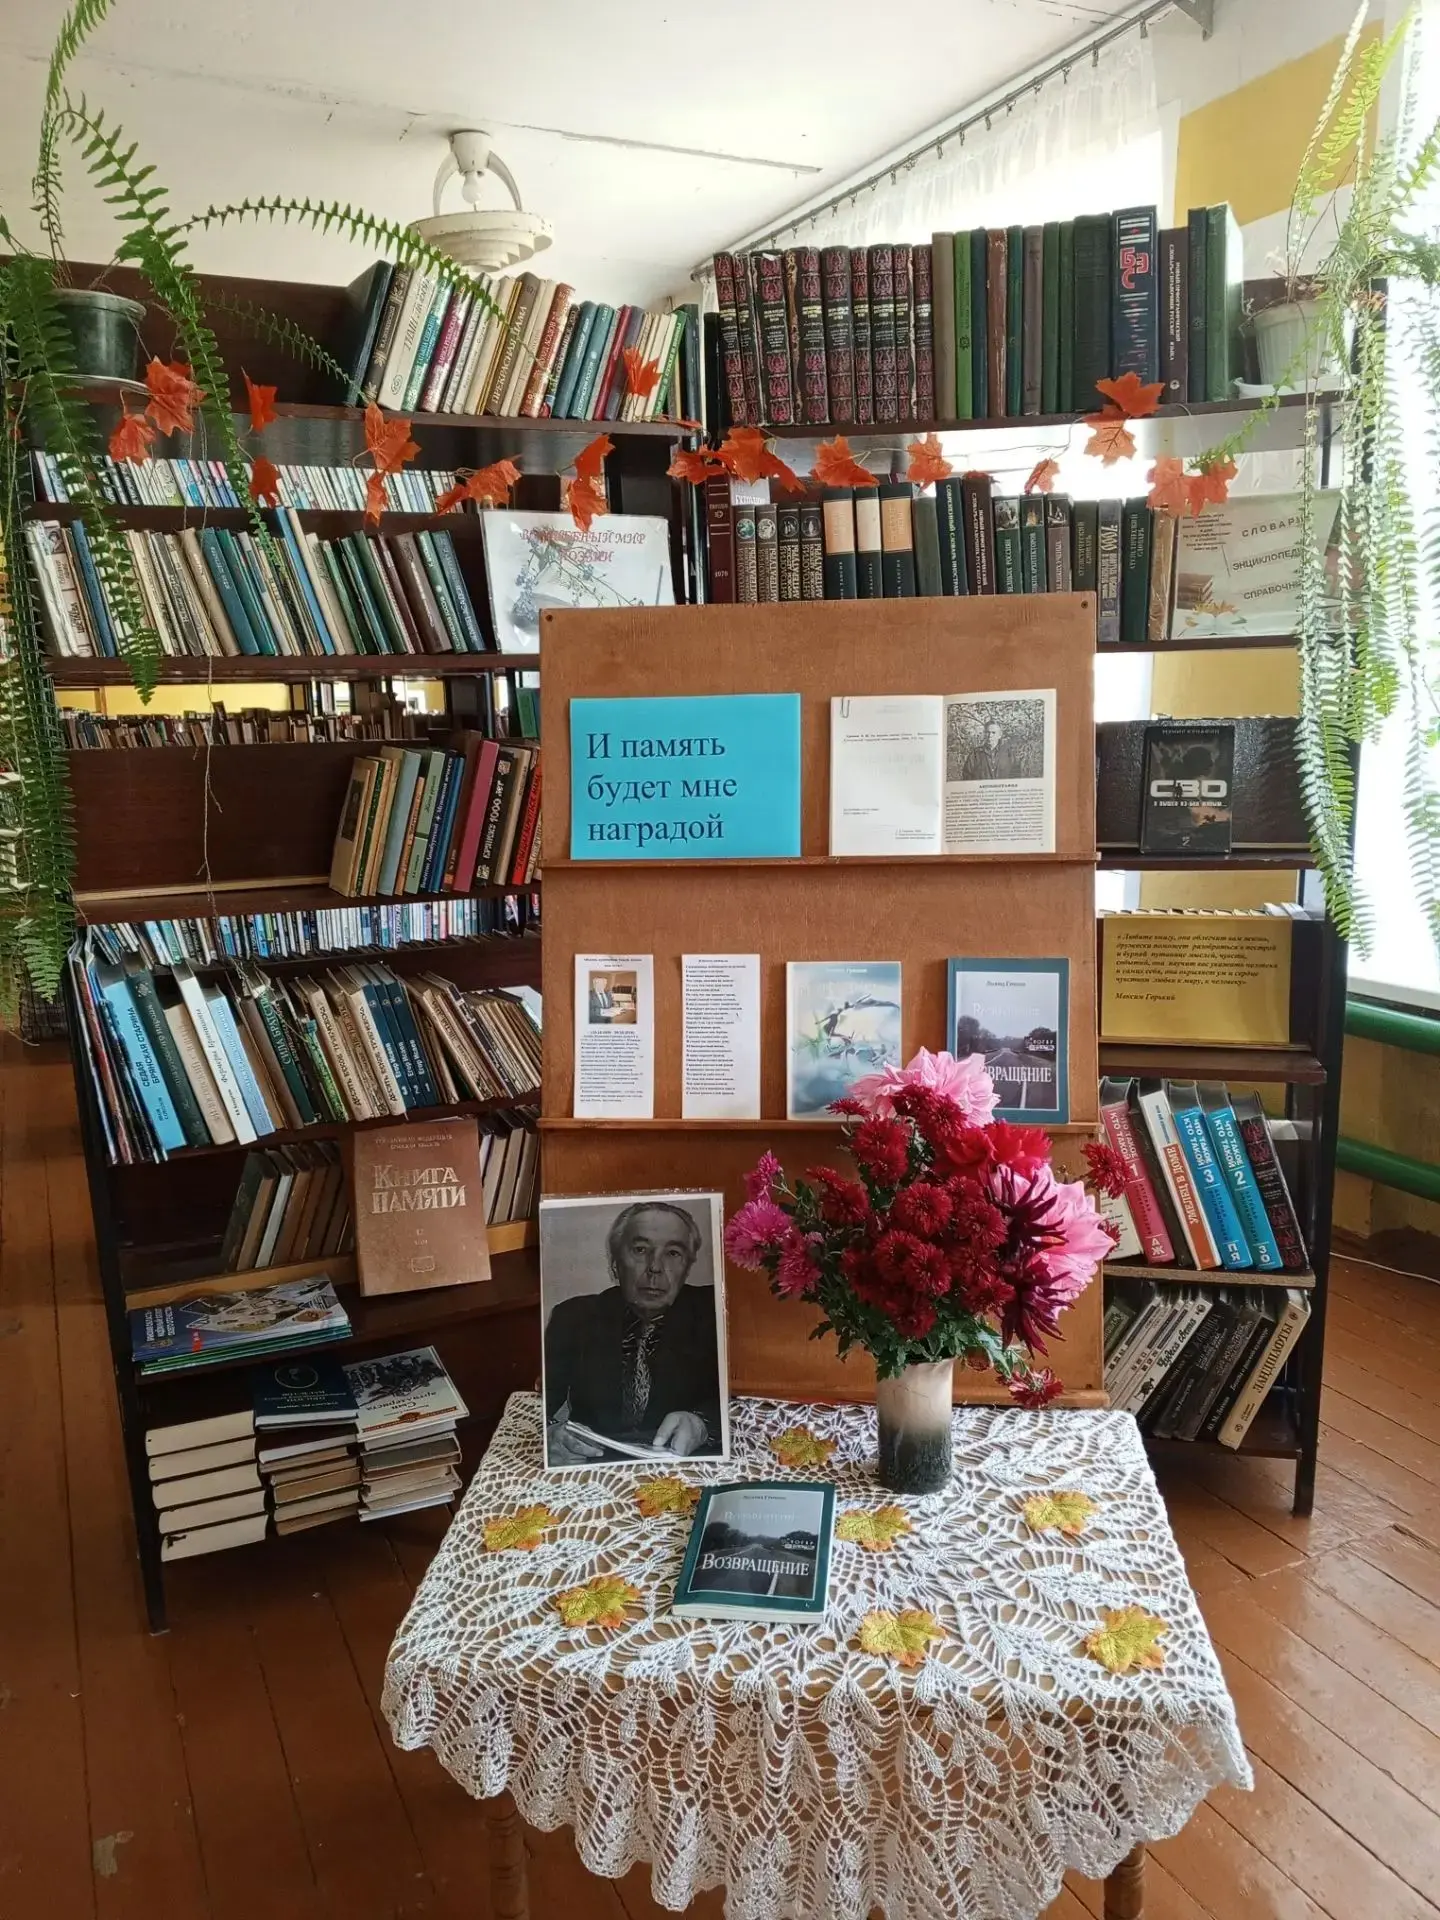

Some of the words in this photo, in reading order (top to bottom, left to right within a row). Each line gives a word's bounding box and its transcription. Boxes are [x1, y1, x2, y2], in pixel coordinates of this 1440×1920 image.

[490, 338, 516, 404] ПРЕКРАСНАЯ
[946, 485, 955, 531] СОВРЕМЕННЫЙ
[615, 532, 646, 544] МИР
[802, 544, 810, 598] АНТОЛОГИЯ
[814, 544, 822, 597] ЛИТЕРАТУРЫ
[1233, 547, 1303, 570] ЭНЦИКЛОПЕД
[737, 548, 745, 601] АНТОЛОГИЯ
[749, 547, 757, 601] ЛИТЕРАТУРЫ
[769, 548, 778, 602] ЛИТЕРАТУРЫ
[586, 733, 610, 759] И
[621, 737, 725, 762] память
[587, 776, 672, 804] будет
[681, 780, 738, 799] мне
[1150, 780, 1227, 798] СВО
[490, 797, 502, 823] 1000
[588, 815, 724, 848] наградой
[1145, 993, 1176, 1002] Горький
[126, 1007, 145, 1044] СТАРИНА
[318, 1006, 340, 1051] ТРУБЧЕВСКА
[357, 1006, 378, 1050] ТРУБЧЕВСКА
[275, 1037, 292, 1065] СИЛА
[373, 1052, 386, 1074] ВЕКОВ
[383, 1043, 395, 1063] Исаев
[396, 1042, 409, 1062] Исаев
[407, 1040, 420, 1060] Исаев
[135, 1061, 151, 1088] СЕДАЯ
[139, 1043, 160, 1085] БРЯНСКАЯ
[335, 1053, 350, 1078] ВЕКОВ
[391, 1062, 404, 1078] Егор
[403, 1061, 415, 1077] Егор
[414, 1059, 426, 1075] Егор
[985, 1066, 1052, 1083] ВРАЩЕНИЕ
[344, 1078, 361, 1107] ДЕСЯТЬ
[381, 1075, 397, 1103] ДЕСЯТЬ
[402, 1086, 408, 1096] 3
[414, 1085, 420, 1094] 2
[425, 1083, 430, 1092] 1
[1110, 1112, 1122, 1130] КТО
[1116, 1131, 1132, 1161] ТАКОЙ
[1125, 1132, 1139, 1158] ТАКОЕ
[1183, 1117, 1195, 1135] КТО
[1190, 1137, 1205, 1166] ТАКОЙ
[1193, 1119, 1203, 1135] ЧТО
[1198, 1137, 1213, 1164] ТАКОЕ
[1215, 1119, 1226, 1137] КТО
[1221, 1140, 1237, 1169] ТАКОЙ
[1224, 1121, 1234, 1138] ЧТО
[1230, 1138, 1244, 1165] ТАКОЕ
[1129, 1163, 1140, 1178] 1
[1166, 1146, 1183, 1175] ДОМЕ
[374, 1165, 460, 1188] КНИГА
[1175, 1175, 1184, 1183] В
[1203, 1168, 1214, 1184] 3
[1234, 1169, 1247, 1186] 2
[372, 1185, 466, 1214] ПАМЯТИ
[1177, 1183, 1199, 1225] УМЕЛЕЦ
[1150, 1238, 1160, 1247] А
[1151, 1245, 1166, 1257] Ж
[1227, 1243, 1237, 1253] П
[1230, 1251, 1240, 1262] Я
[1156, 1339, 1183, 1371] Чудеса
[1174, 1316, 1198, 1344] света
[1252, 1322, 1294, 1394] ЛАНДШАФТЫ
[391, 1401, 416, 1412] Сын
[702, 1553, 809, 1576] ВОЗВРАЩЕНИЕ
